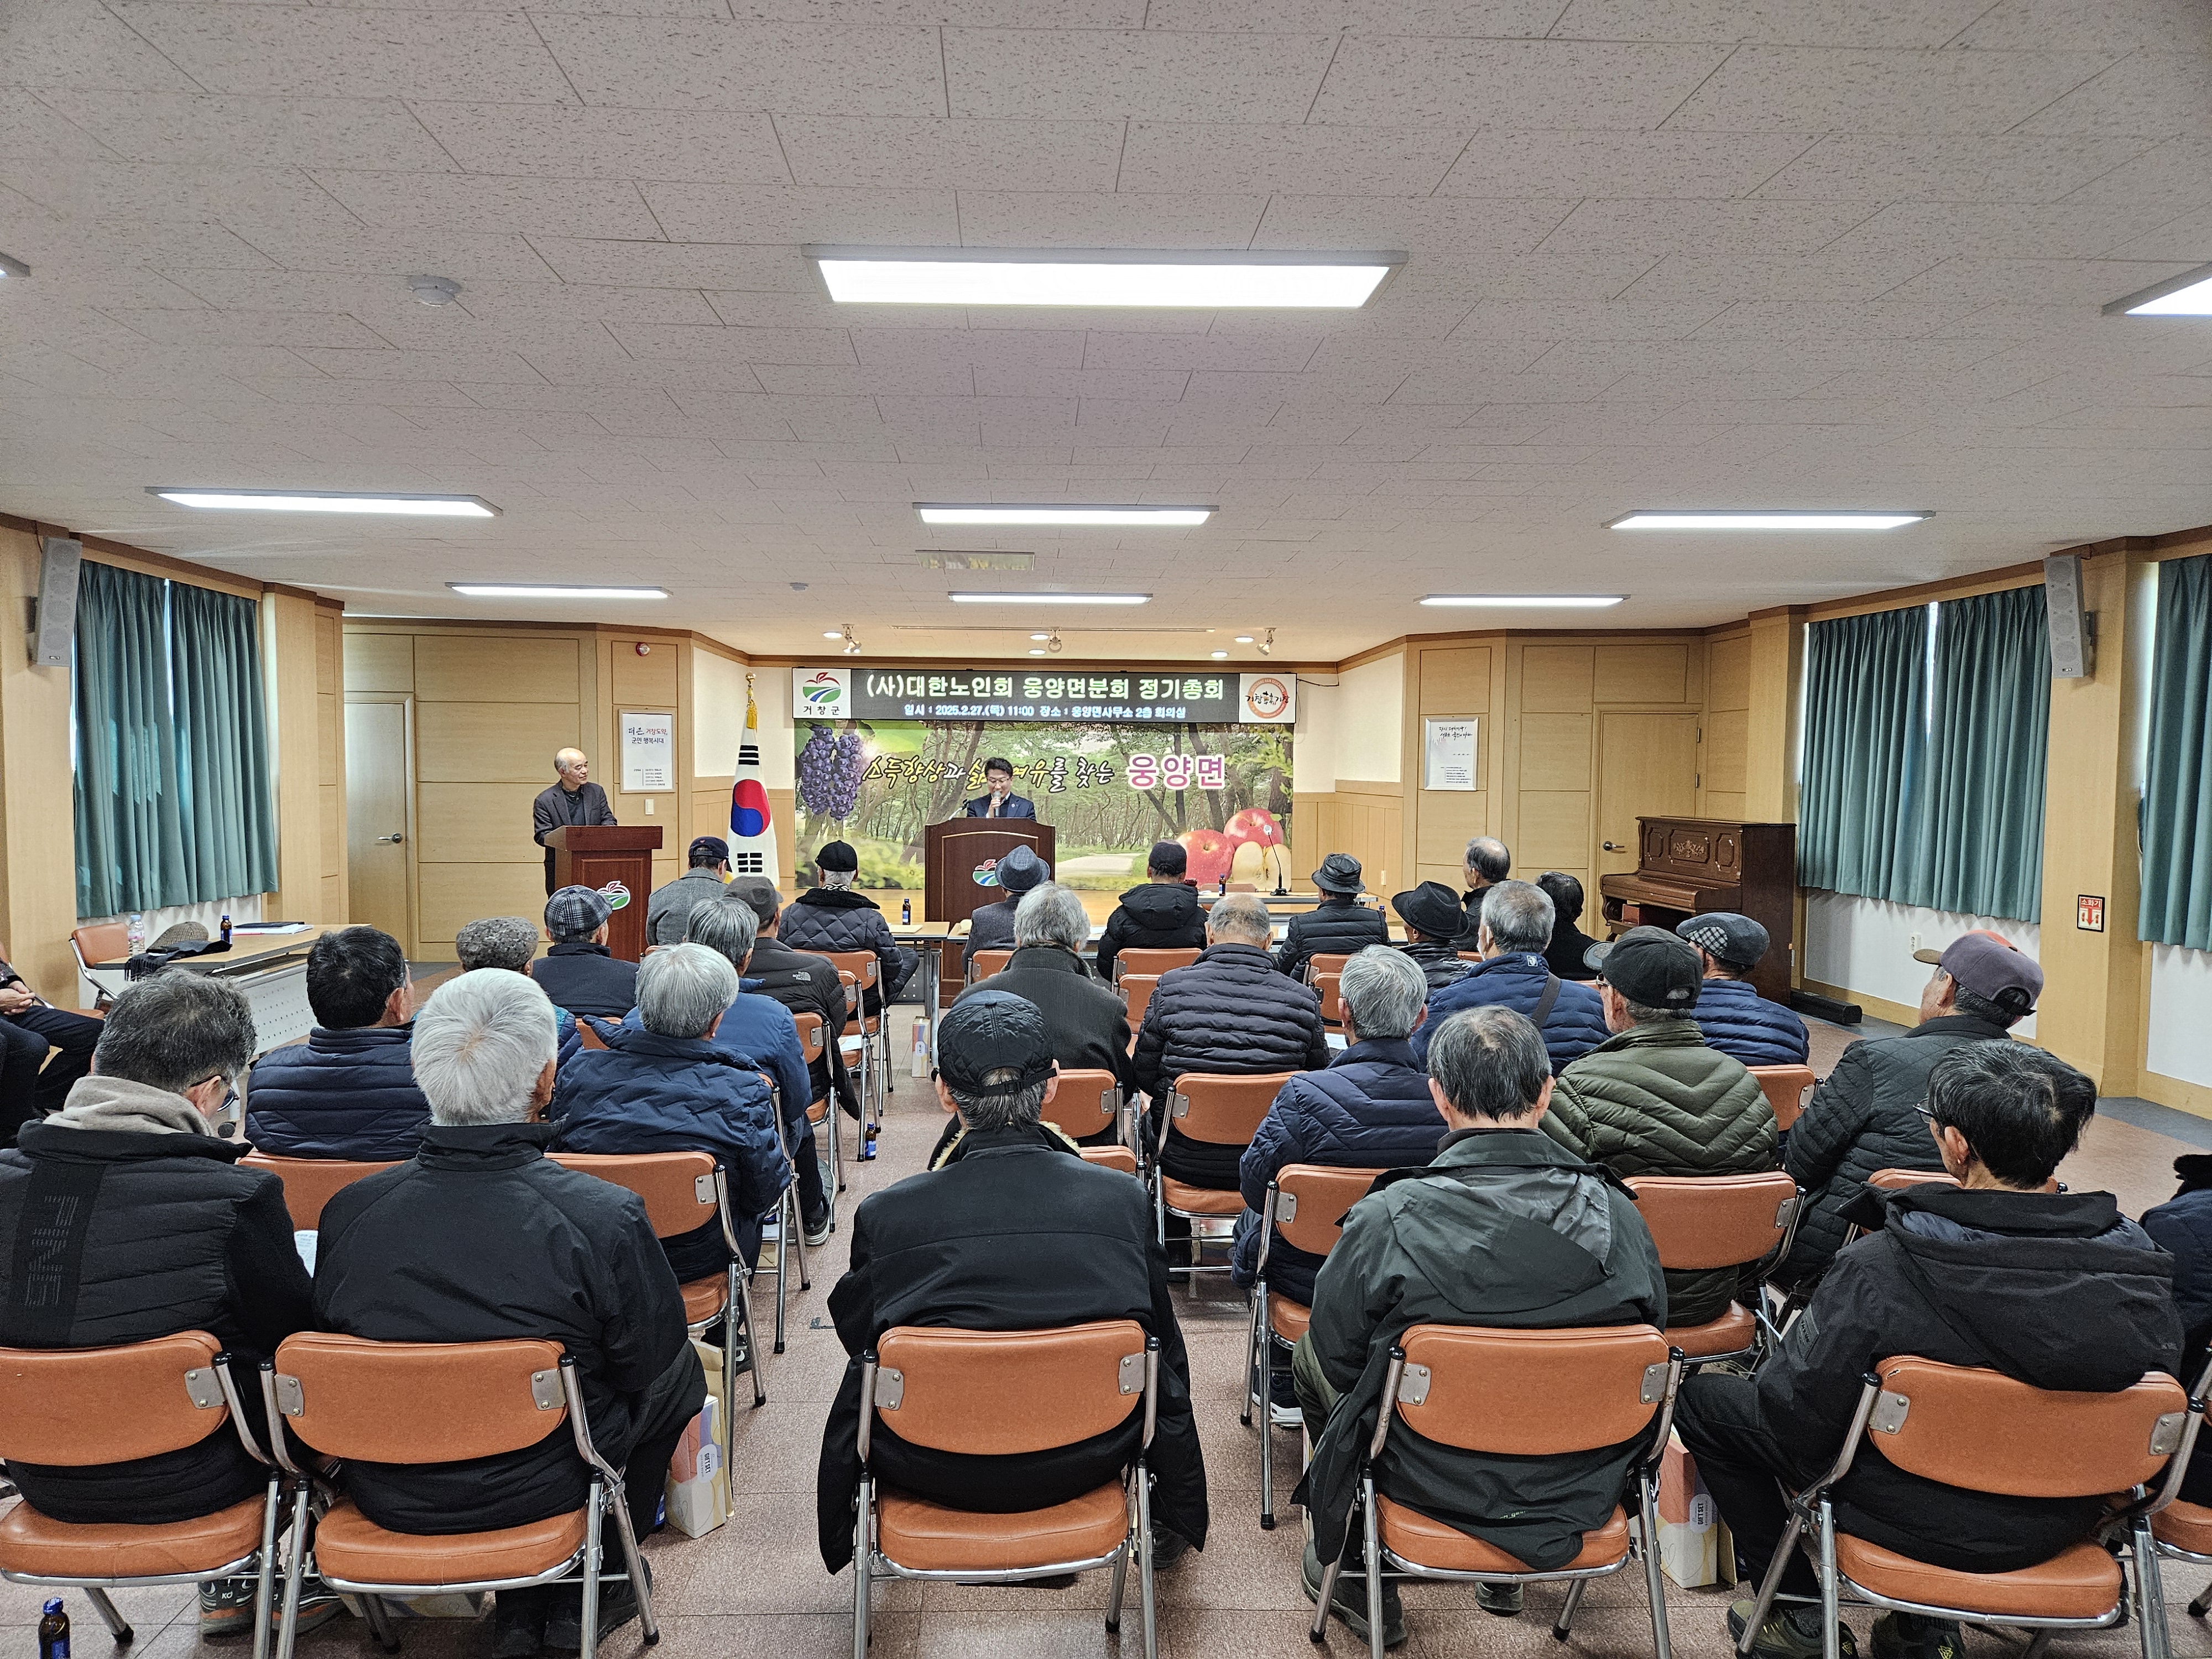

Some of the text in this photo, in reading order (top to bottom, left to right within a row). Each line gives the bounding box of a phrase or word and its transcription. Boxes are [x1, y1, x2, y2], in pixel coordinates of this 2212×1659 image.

[867, 674, 1223, 700] (사)대한노인회 웅양면분회 정기총회
[803, 706, 840, 716] 거창군
[904, 704, 925, 716] 일시
[935, 705, 1005, 717] 2025.2.27.(목)
[1008, 705, 1035, 716] 11:00
[1040, 705, 1062, 717] 장소
[1072, 706, 1133, 718] 웅양면사무소
[1135, 707, 1152, 718] 2층
[1155, 707, 1186, 718] 회의실
[862, 755, 966, 789] 소득향상과
[966, 758, 988, 791] 삶
[1076, 756, 1115, 789] 찾는
[1126, 753, 1225, 790] 웅양면
[2081, 899, 2101, 907] 소화기
